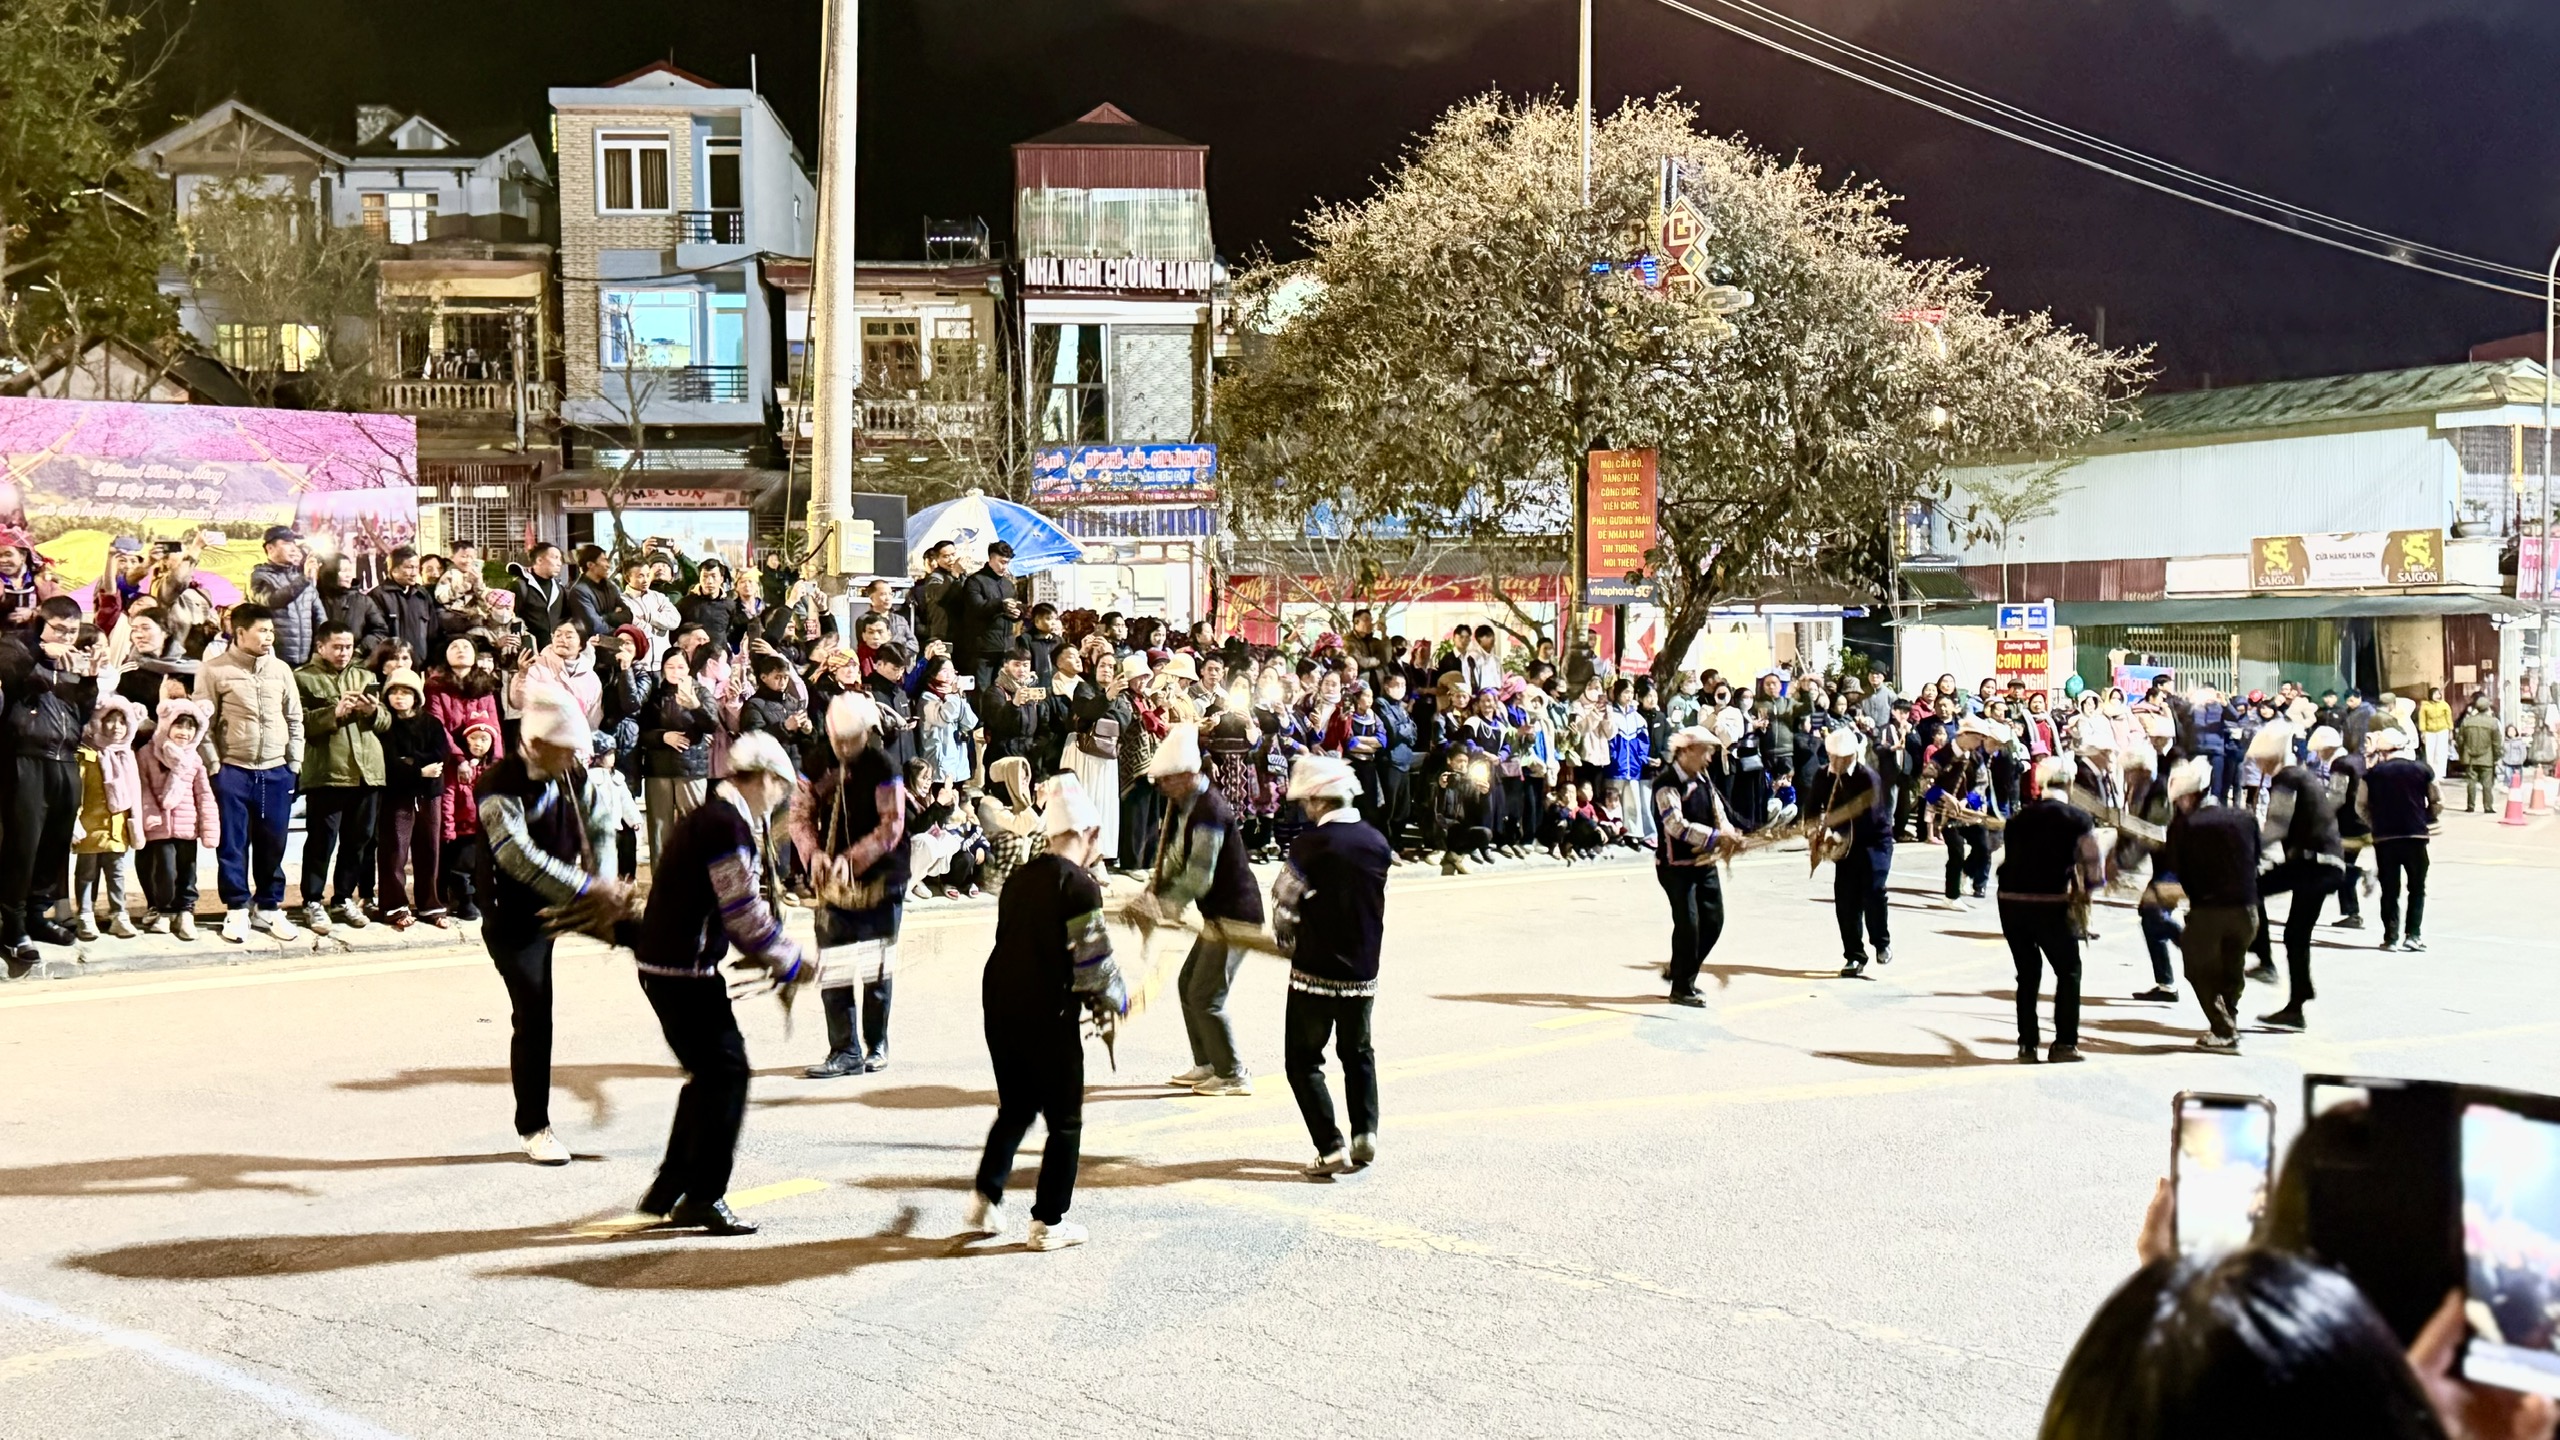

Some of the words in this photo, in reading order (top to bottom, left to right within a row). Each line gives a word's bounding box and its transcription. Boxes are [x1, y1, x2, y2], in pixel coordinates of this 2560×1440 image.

[1164, 259, 1211, 296] HẠNH
[2258, 573, 2296, 586] SAIGON
[2397, 571, 2439, 584] SAIGON
[1589, 585, 1635, 598] vinaphone
[1997, 652, 2022, 669] CƠM
[2024, 649, 2048, 669] PHỞ
